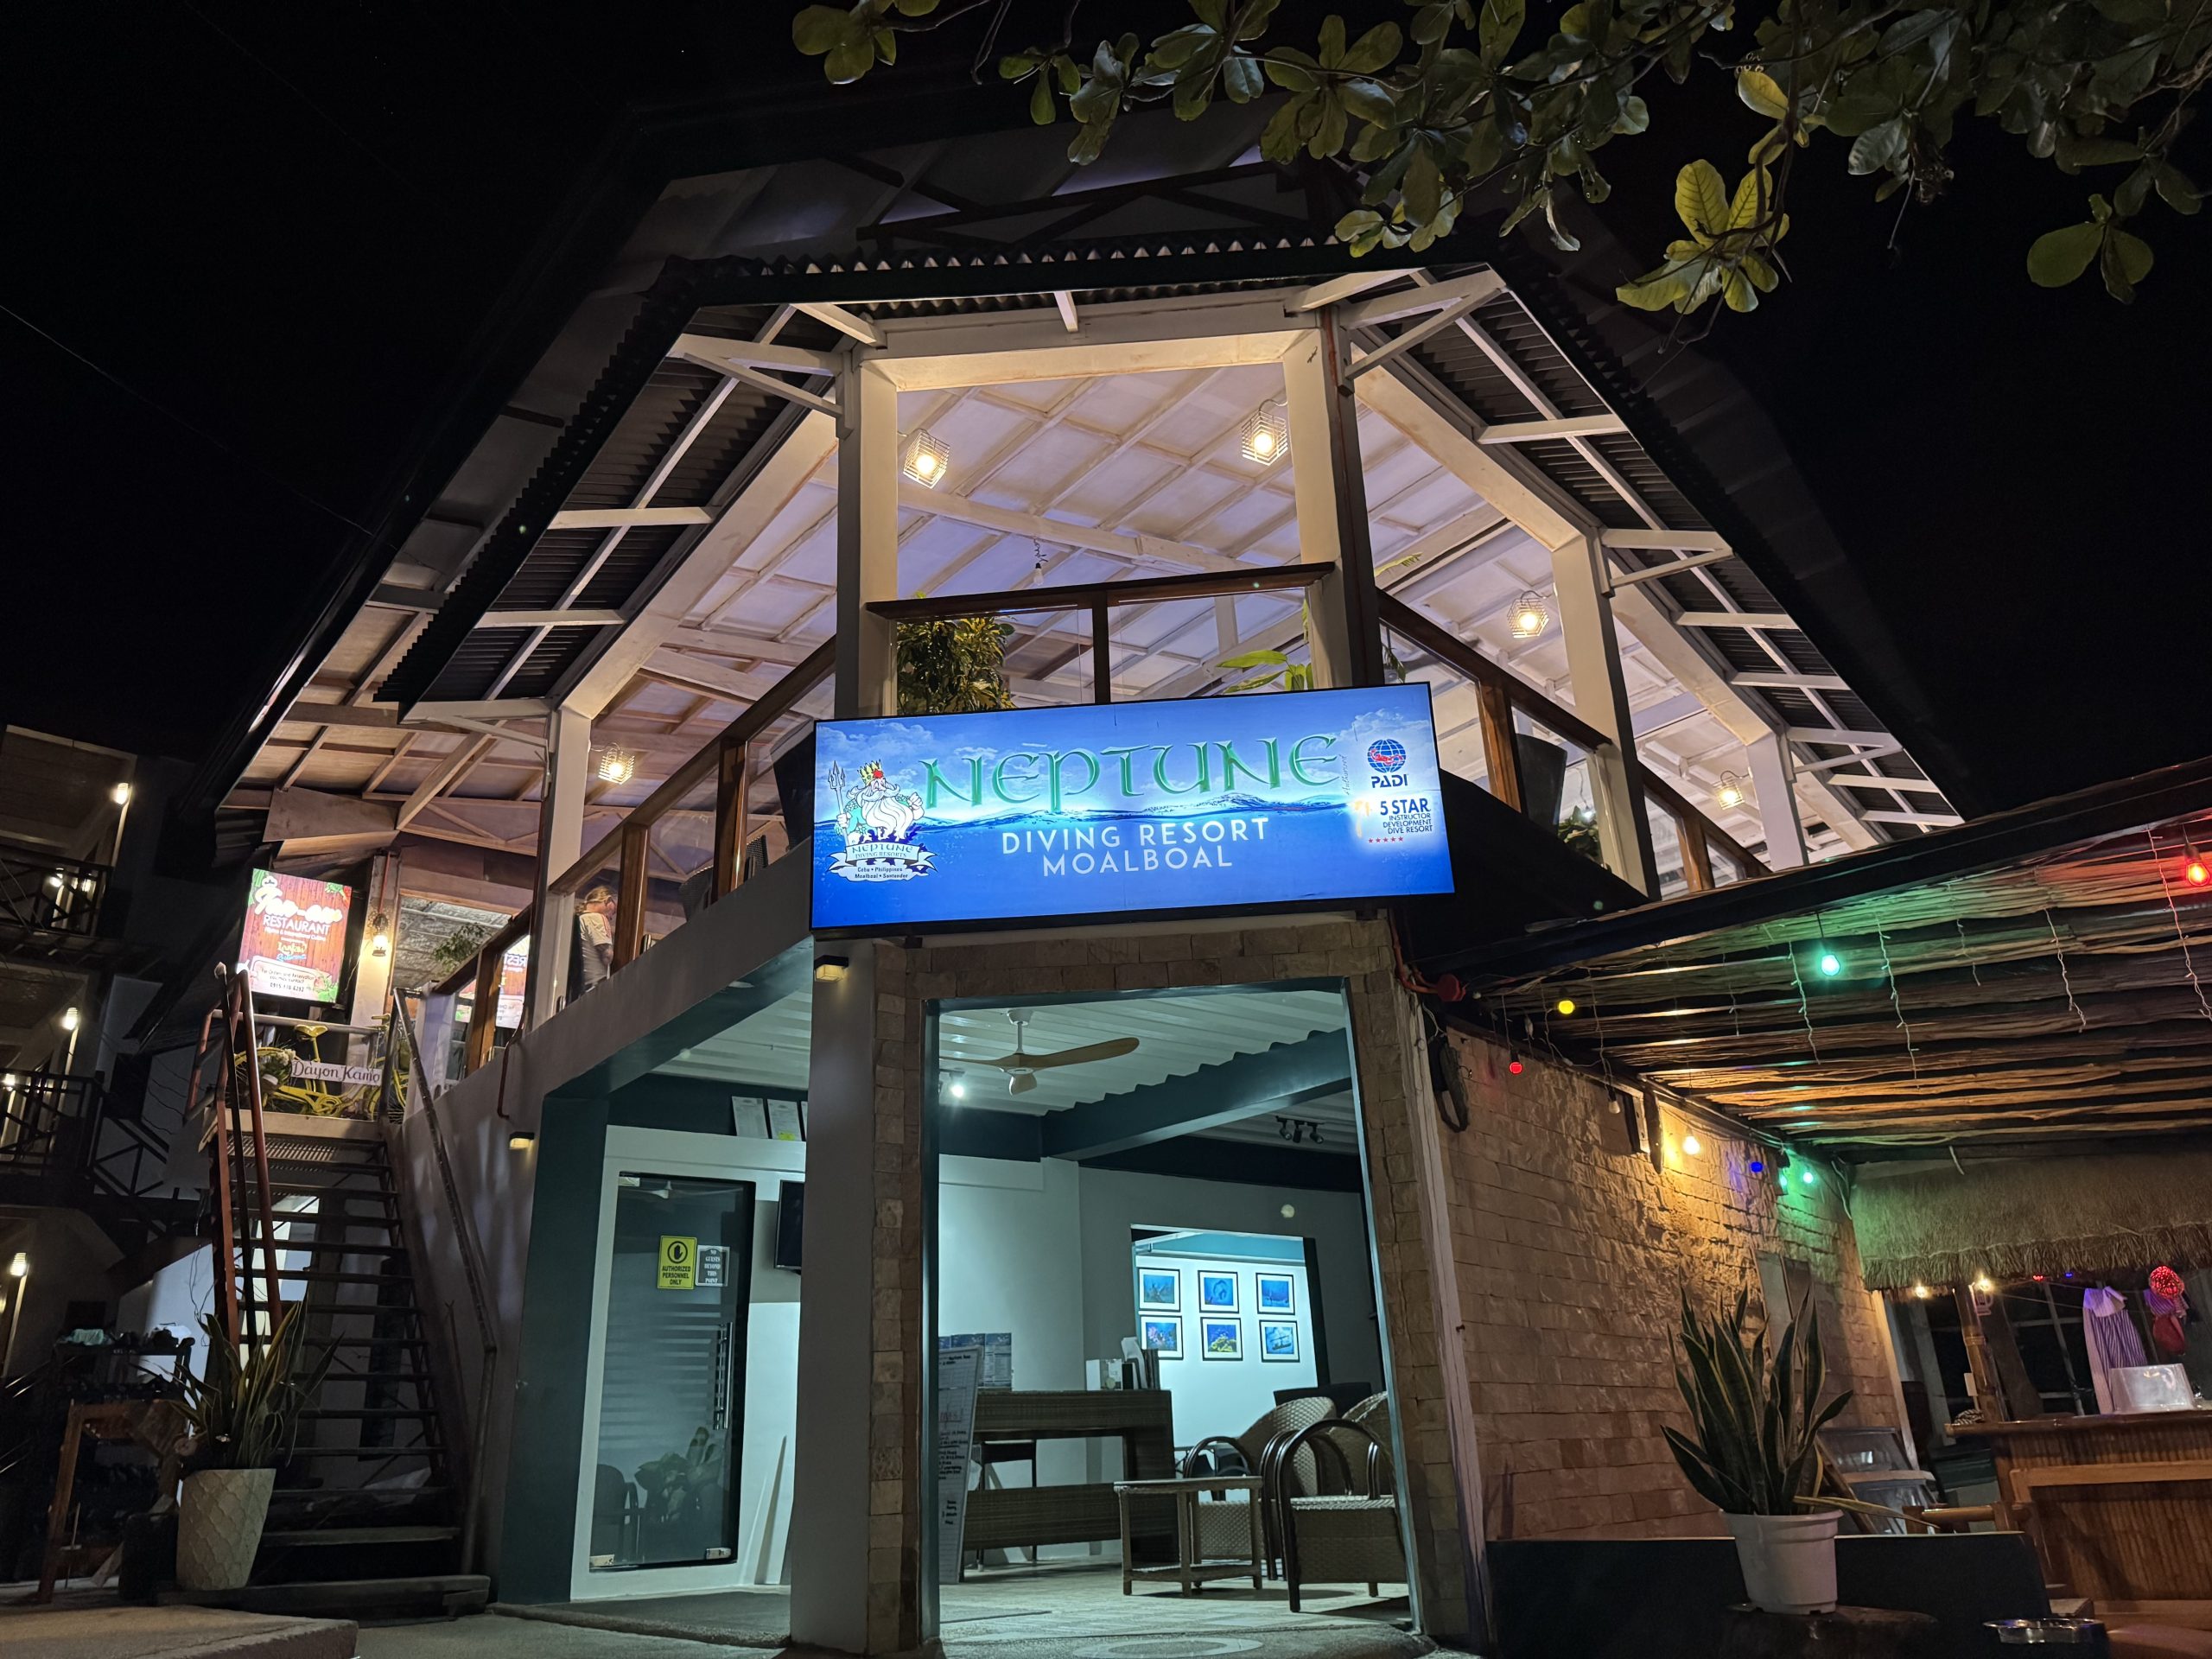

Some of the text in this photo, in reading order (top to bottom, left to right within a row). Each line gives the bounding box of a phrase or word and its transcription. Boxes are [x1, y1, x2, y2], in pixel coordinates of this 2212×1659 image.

[918, 734, 1339, 813] NEPTUNE
[1370, 773, 1408, 788] PADI
[1380, 798, 1431, 816] 5 STAR
[1382, 818, 1432, 828] DEVELOPMENT
[1389, 812, 1431, 821] INSTRUCTOR
[1002, 817, 1268, 855] DIVING RESORT
[1406, 824, 1433, 833] RESORT
[852, 843, 913, 854] NEPTUNE
[1043, 845, 1233, 876] MOALBOAL
[263, 914, 331, 936] RESTAURANT
[292, 1060, 380, 1082] Dayon Kamo
